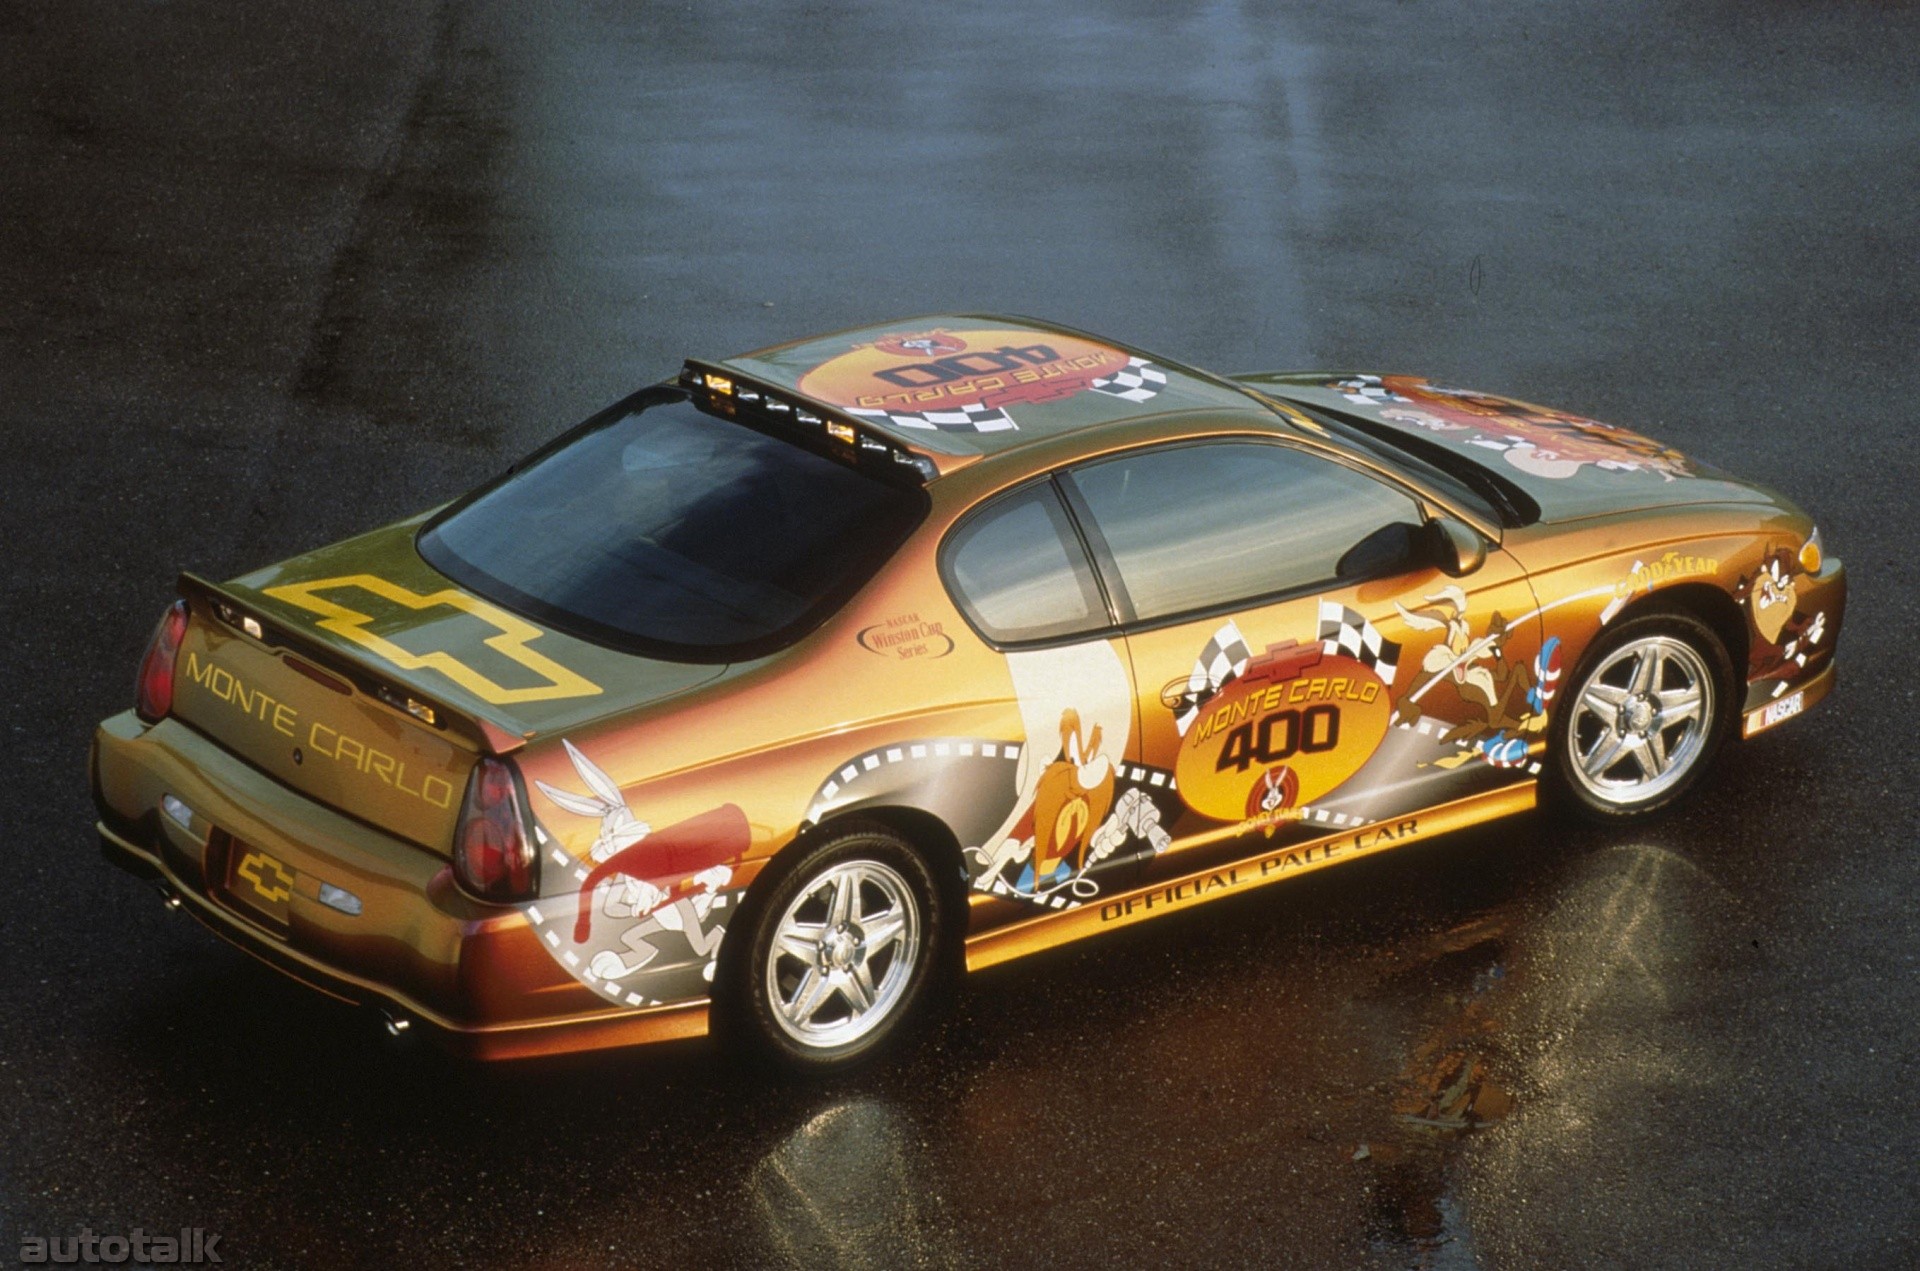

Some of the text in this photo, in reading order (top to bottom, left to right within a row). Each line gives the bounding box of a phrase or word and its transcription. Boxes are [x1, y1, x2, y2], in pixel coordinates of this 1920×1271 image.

[856, 351, 1115, 408] MONTE CARLO
[873, 344, 1061, 388] 400
[1615, 552, 1718, 599] GOODYEAR
[871, 621, 943, 649] Winston Cup
[897, 643, 928, 660] Series
[186, 652, 453, 810] MONTE CARLO
[1192, 677, 1380, 748] MONTE CARLO
[1214, 703, 1341, 774] 400
[1100, 819, 1419, 922] OFFICIAL PACE CAR
